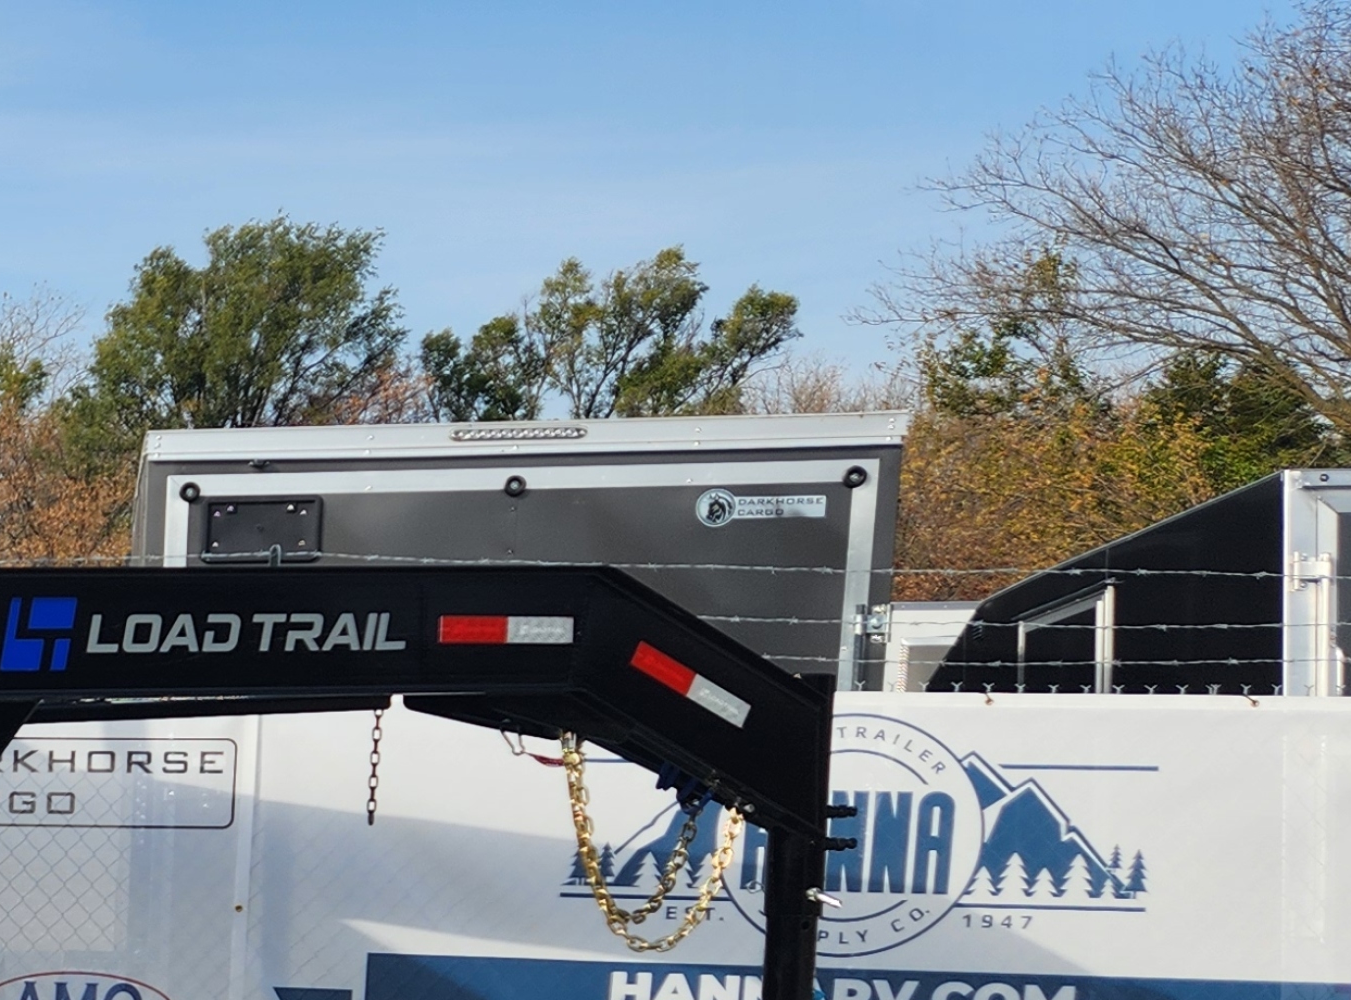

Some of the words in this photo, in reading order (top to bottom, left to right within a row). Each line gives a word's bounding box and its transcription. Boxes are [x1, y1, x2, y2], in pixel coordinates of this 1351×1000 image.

[737, 497, 825, 507] DARKHORSE
[737, 508, 784, 517] CARGO
[86, 613, 242, 653] LOAD
[252, 612, 406, 652] TRAIL
[836, 726, 947, 775] TRAILER
[890, 907, 931, 933] CO.
[963, 913, 1035, 931] 1947
